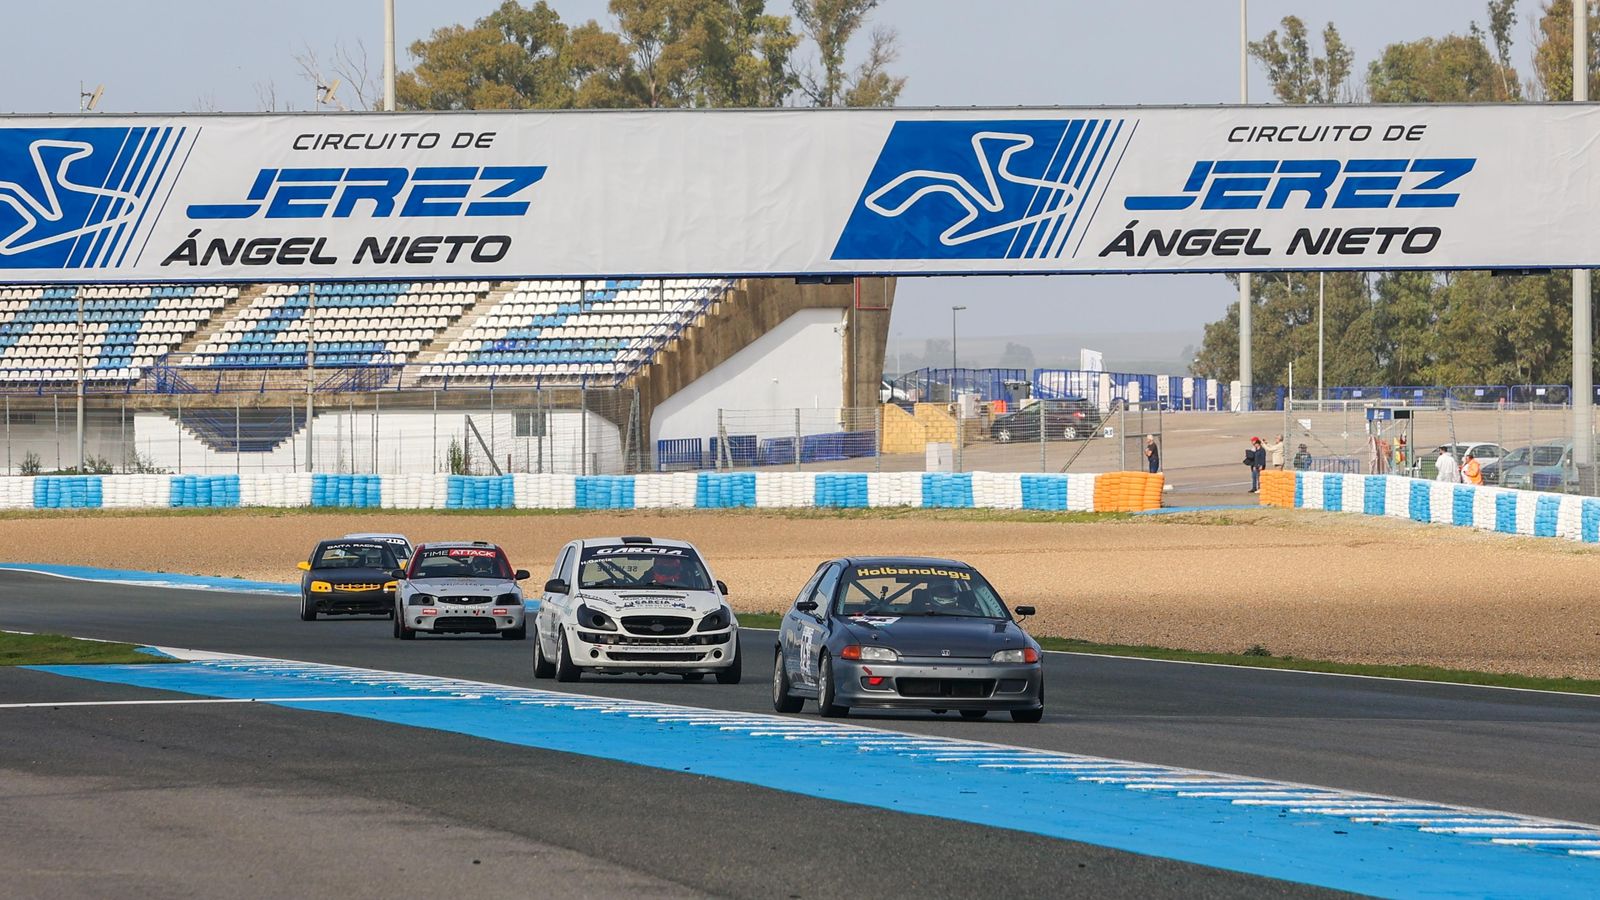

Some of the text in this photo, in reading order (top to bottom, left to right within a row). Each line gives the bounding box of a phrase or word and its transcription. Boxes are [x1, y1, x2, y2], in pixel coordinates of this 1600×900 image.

[292, 133, 496, 150] CIRCUITO DE
[1227, 125, 1427, 142] CIRCUITO DE
[186, 165, 547, 220] JEREZ
[1124, 158, 1477, 211] JEREZ
[1098, 219, 1442, 257] ÁNGEL NIETO
[160, 228, 512, 267] ÁNGEL NIETO
[450, 549, 494, 557] ATTACK
[596, 547, 683, 555] GARCIA
[857, 567, 971, 581] Holbanology
